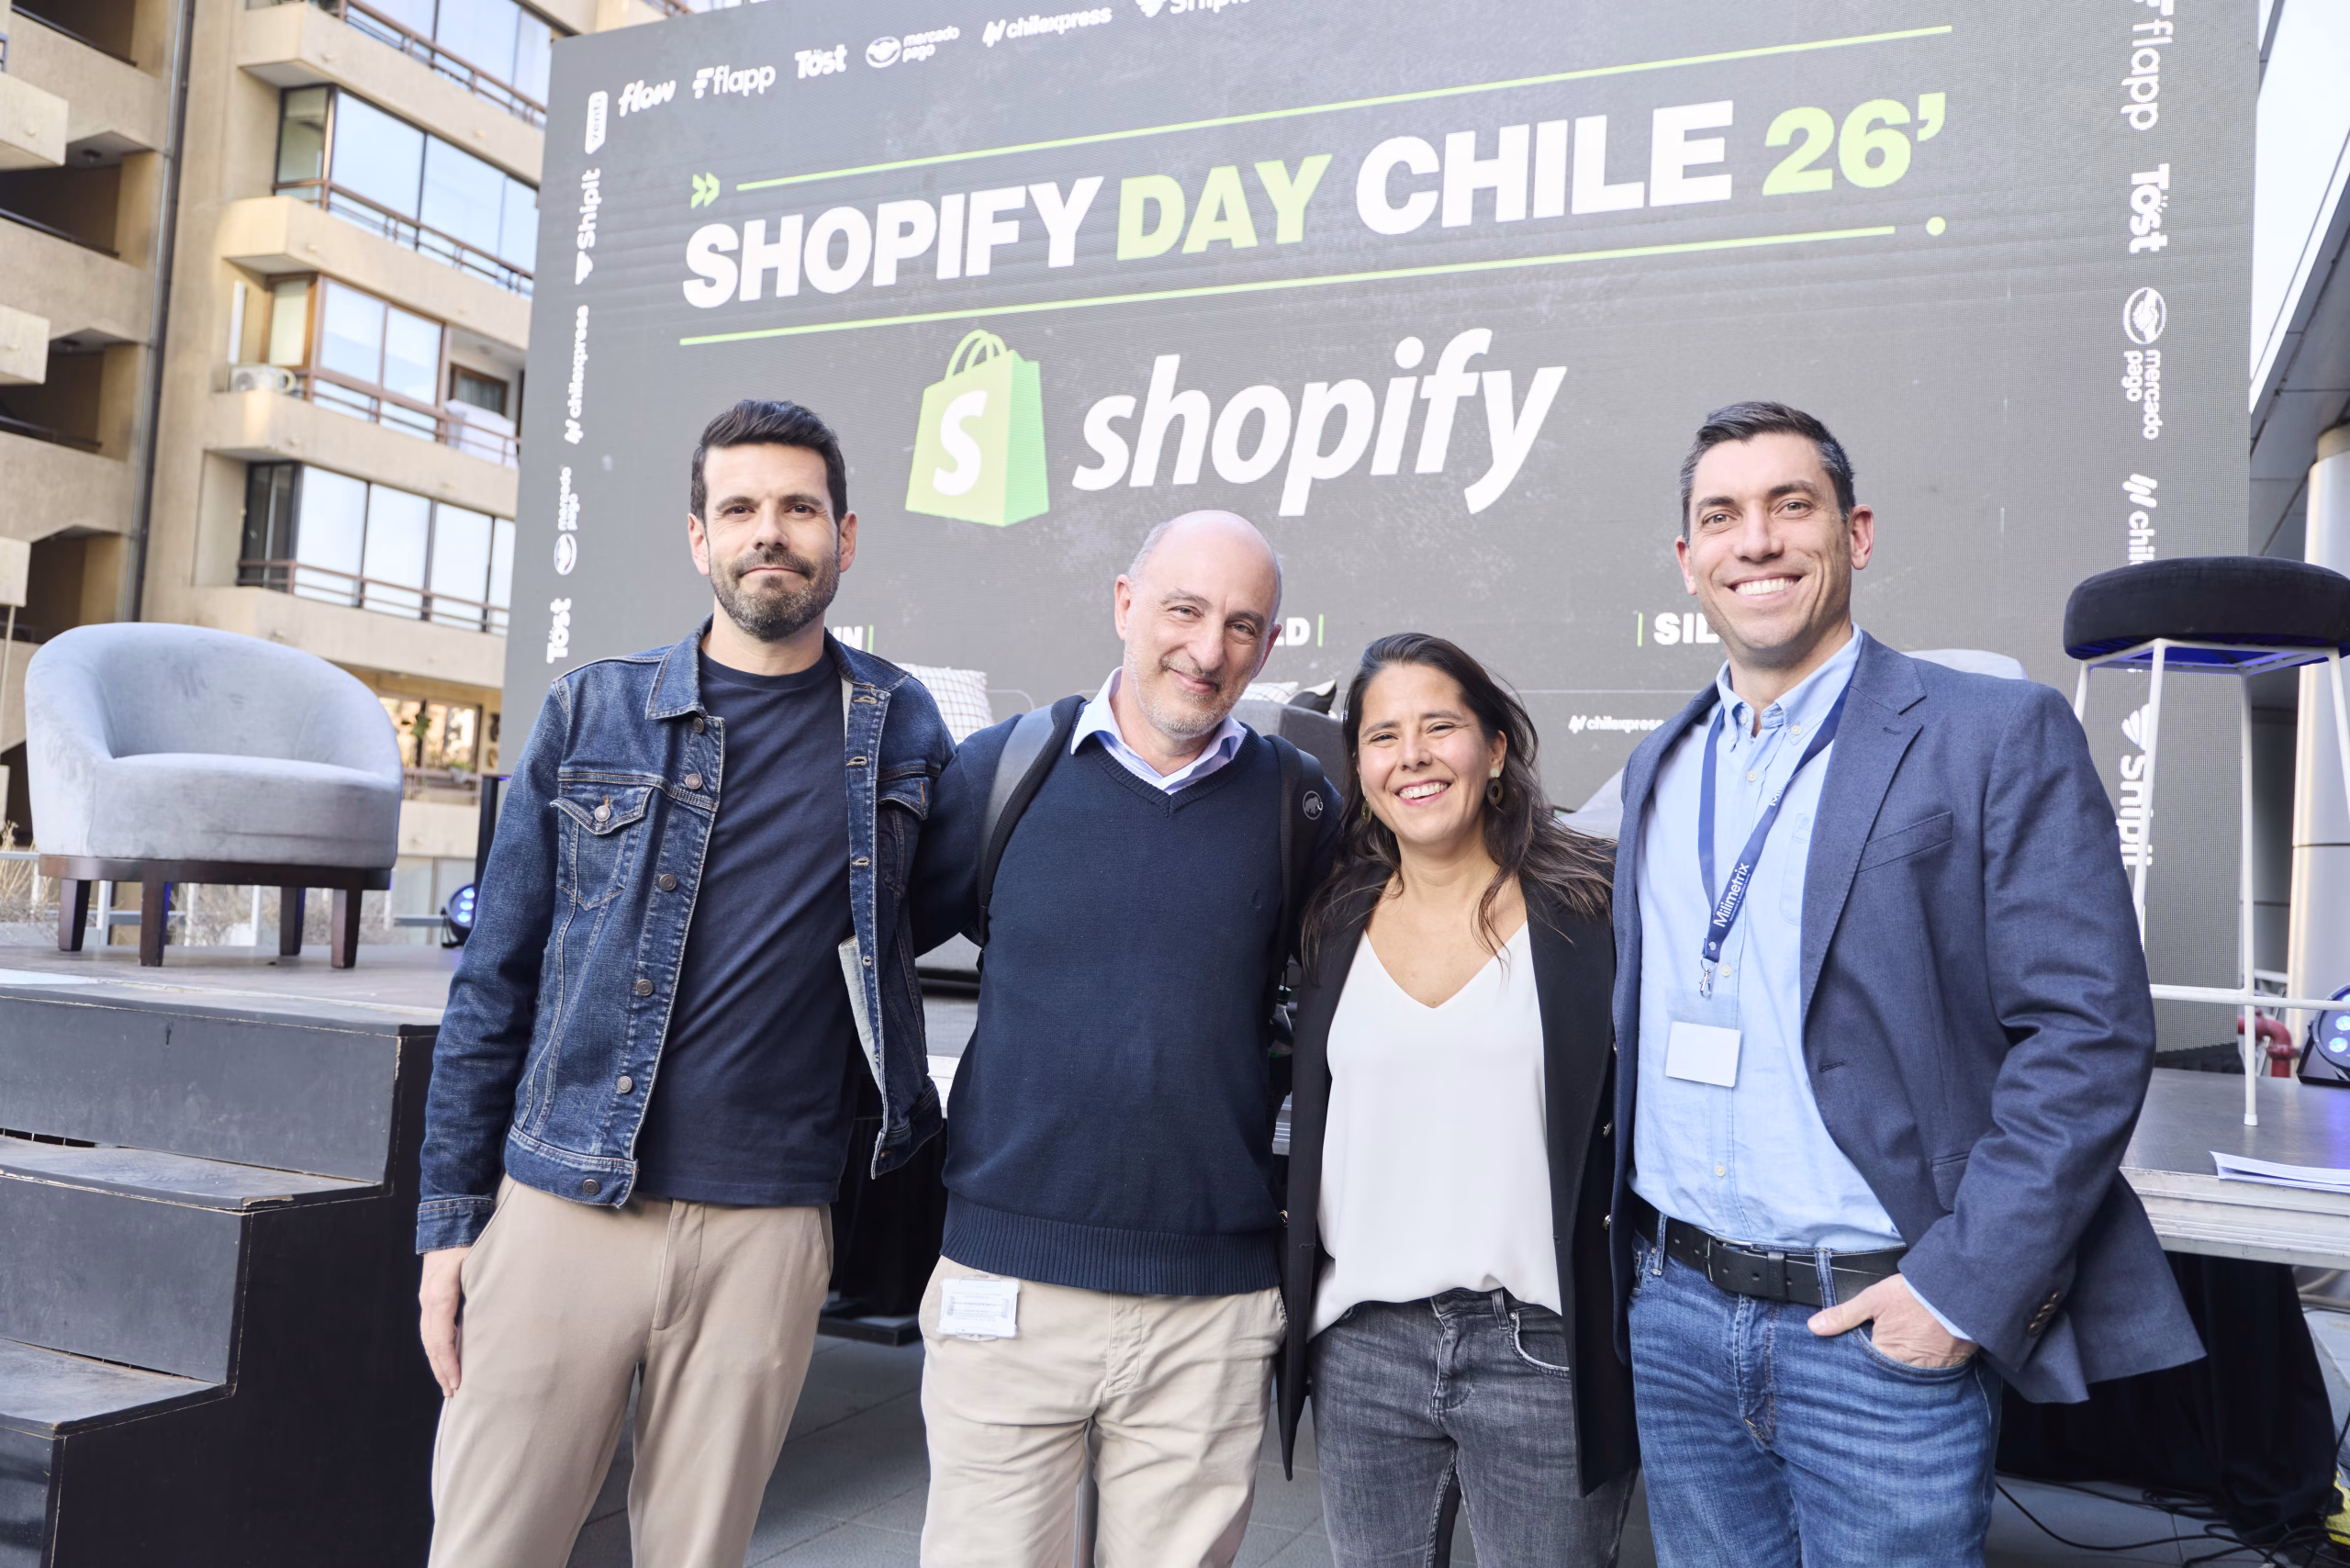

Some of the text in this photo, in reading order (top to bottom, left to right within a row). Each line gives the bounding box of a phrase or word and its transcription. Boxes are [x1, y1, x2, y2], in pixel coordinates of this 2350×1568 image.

[903, 26, 960, 47] mercado
[1006, 7, 1112, 36] chilexpress
[902, 44, 936, 62] pago
[2121, 18, 2174, 131] flapp
[618, 80, 677, 117] flow
[712, 65, 776, 97] flapp
[576, 168, 602, 250] Shipit
[682, 176, 1105, 308] SHOPIFY
[1117, 154, 1332, 260] DAY
[1356, 100, 1734, 236] CHILE
[2121, 350, 2143, 402] pago
[2142, 350, 2163, 441] mercado
[1071, 328, 1568, 518] shopify
[2129, 510, 2155, 565] chil
[1653, 612, 1719, 645] SIL
[1713, 863, 1750, 927] Milimetrix
